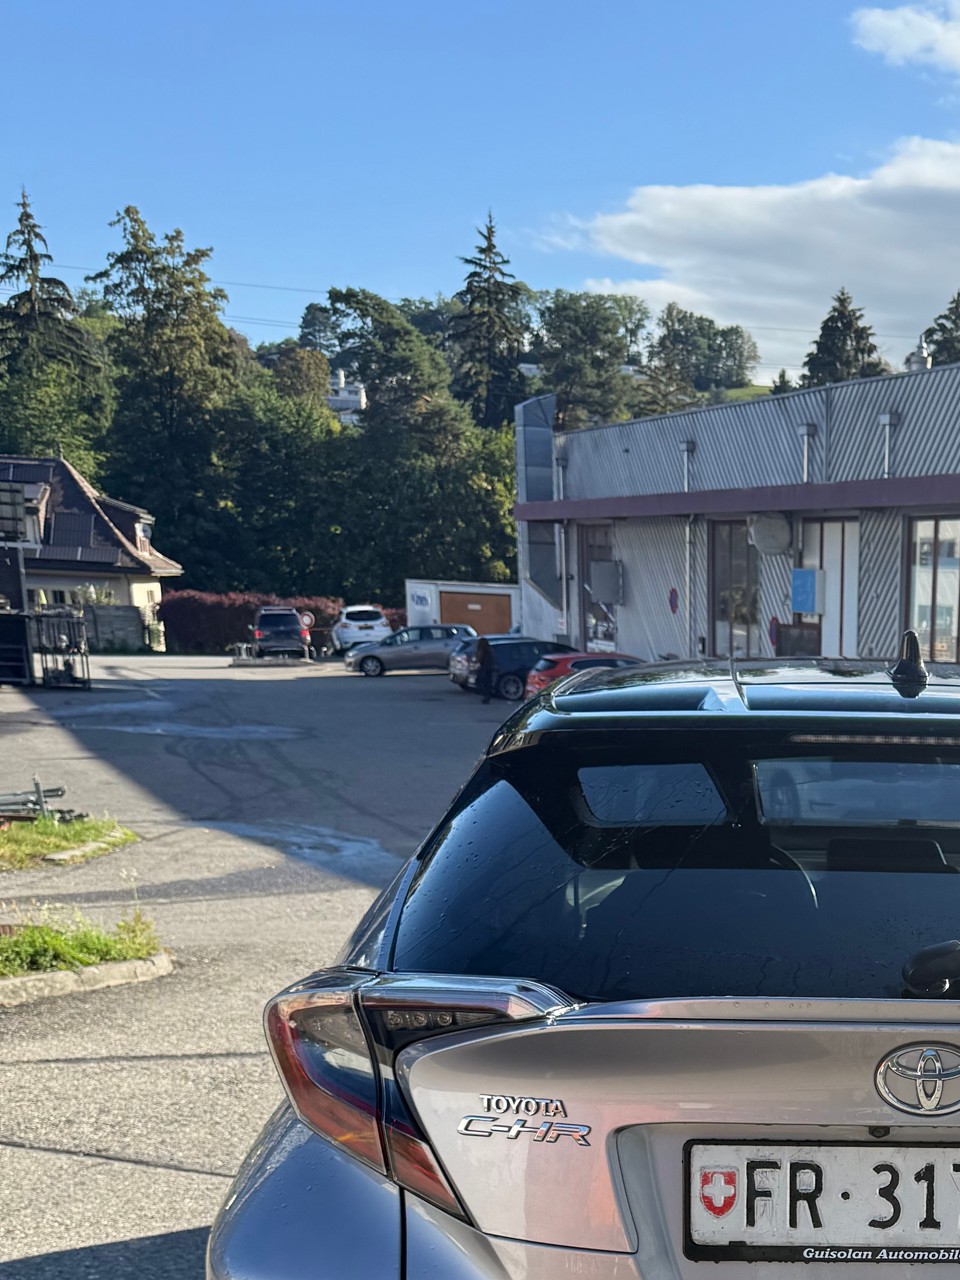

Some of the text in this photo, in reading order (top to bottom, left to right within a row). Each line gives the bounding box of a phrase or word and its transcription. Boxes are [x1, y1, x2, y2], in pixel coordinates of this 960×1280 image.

[479, 1094, 568, 1118] TOYOTA
[457, 1115, 592, 1146] C-HR
[803, 1248, 873, 1259] Guisolan
